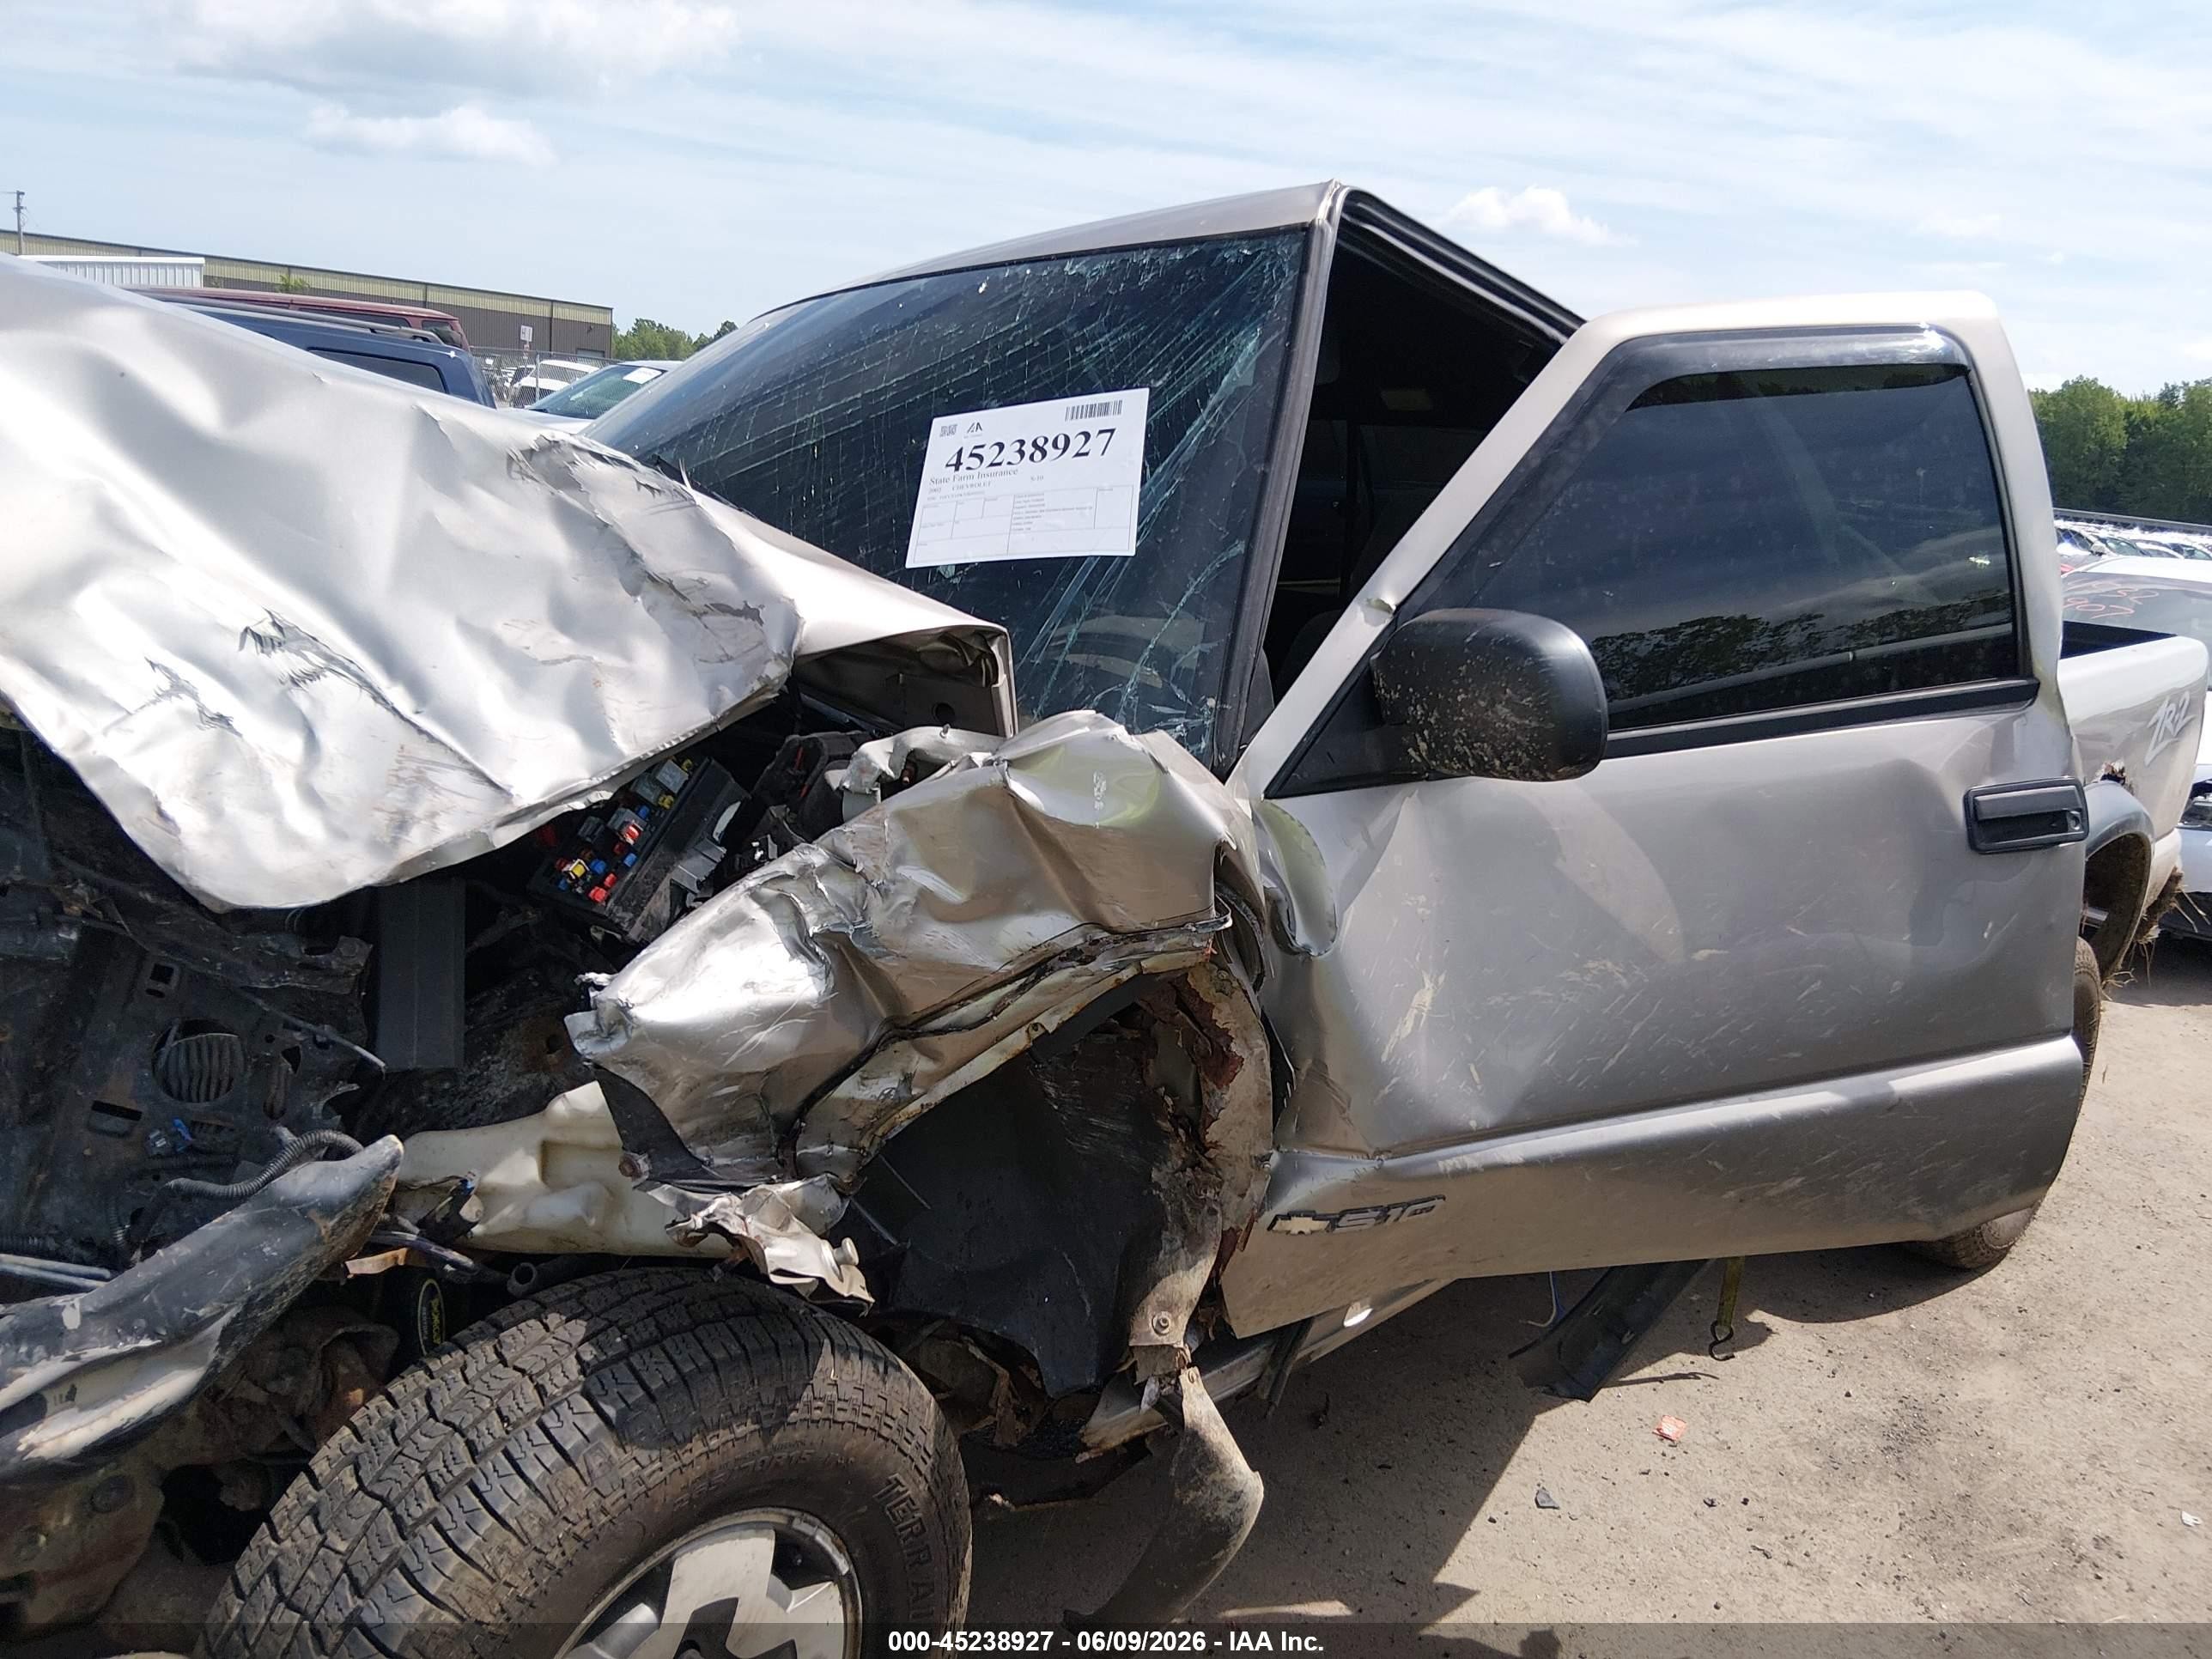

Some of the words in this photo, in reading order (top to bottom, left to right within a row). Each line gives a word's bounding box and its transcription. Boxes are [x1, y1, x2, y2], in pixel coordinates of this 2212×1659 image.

[945, 428, 1117, 473] 45238927
[929, 477, 951, 486] State
[952, 474, 975, 483] Farm
[977, 468, 1019, 480] Insurance
